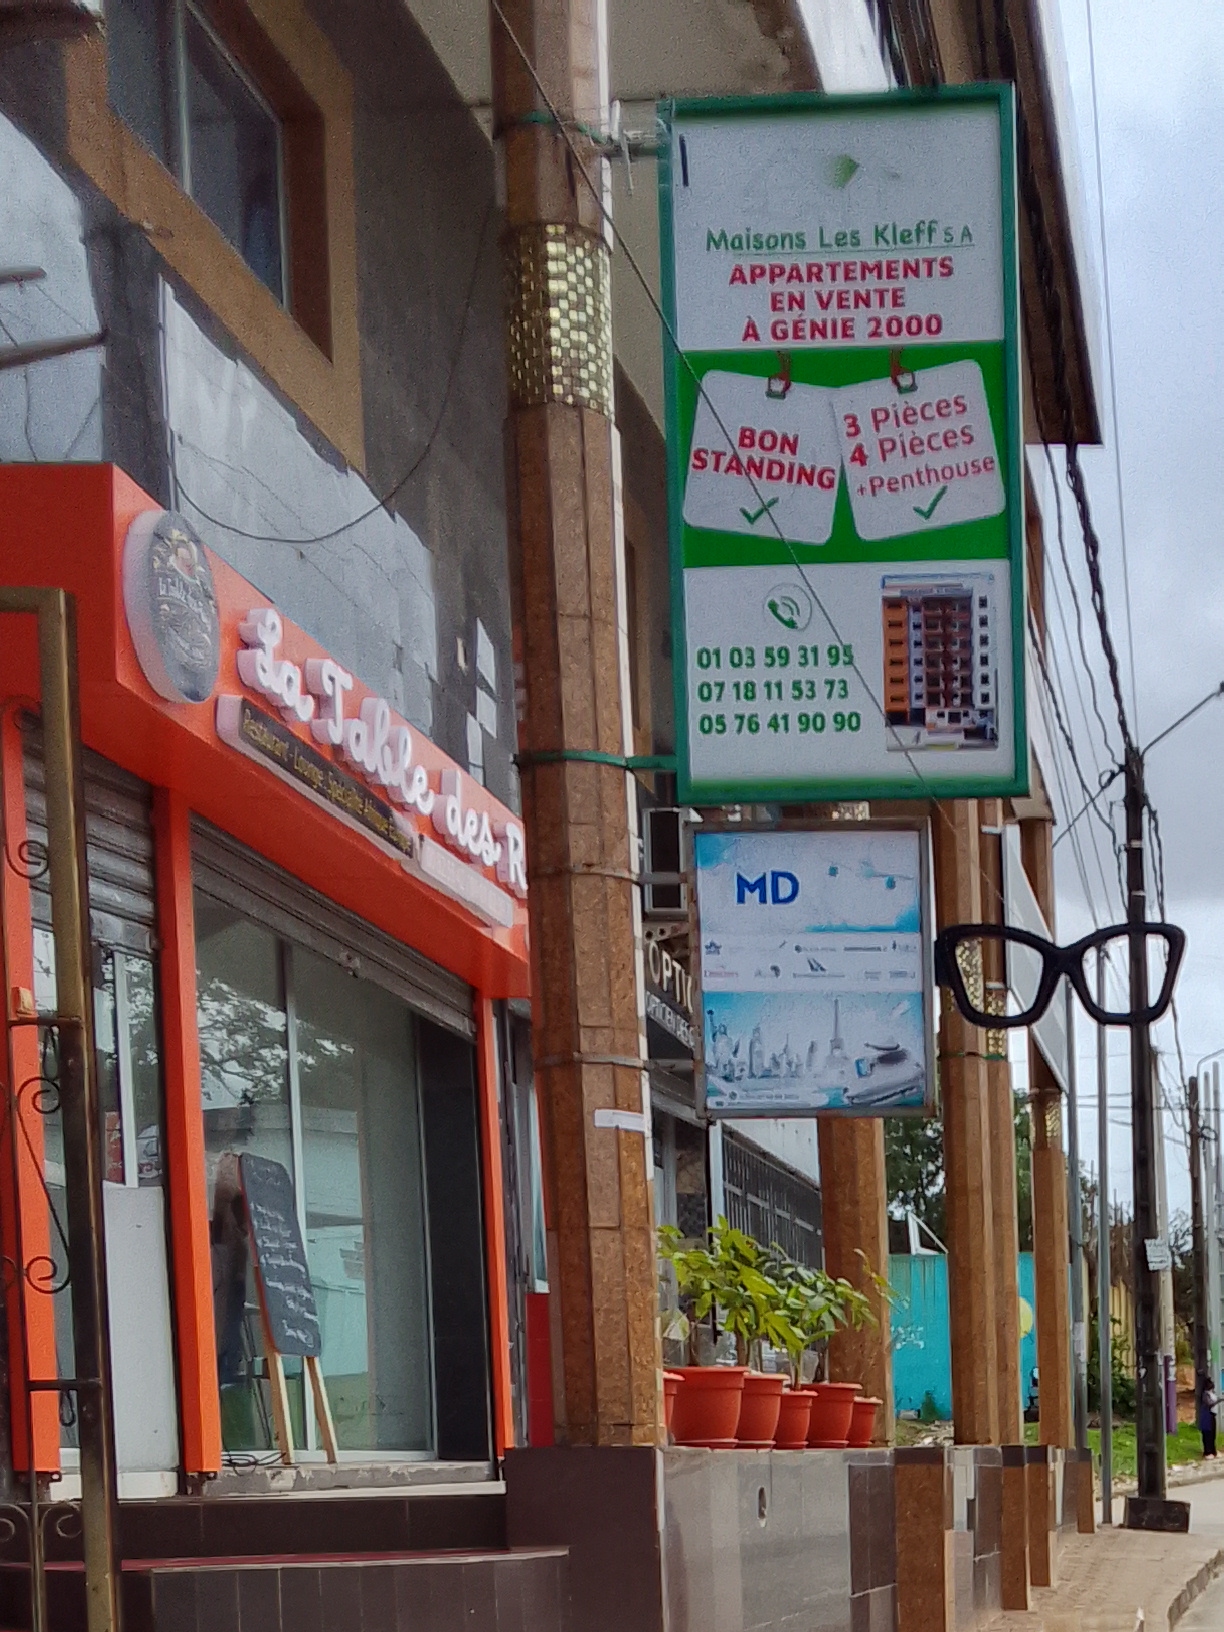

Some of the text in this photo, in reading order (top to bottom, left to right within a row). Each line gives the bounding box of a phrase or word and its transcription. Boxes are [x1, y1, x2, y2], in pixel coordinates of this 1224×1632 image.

[706, 227, 806, 251] Maisons
[819, 226, 860, 248] Les
[875, 219, 938, 247] Kleff
[729, 256, 954, 286] APPARTEMENTS
[770, 287, 906, 313] EN VENTE
[741, 312, 943, 341] À GÉNIE 2000
[843, 394, 967, 437] 3 Pièces
[738, 426, 799, 456] BON
[850, 425, 974, 467] 4 Pièces
[692, 448, 836, 490] STANDING
[697, 646, 721, 669] 01
[729, 645, 755, 668] 03
[764, 645, 790, 668] 59
[798, 644, 818, 667] 31
[698, 678, 849, 702] 07 18 11 53 73
[699, 711, 861, 735] 05 76 41 90 90
[314, 658, 435, 816] Table
[436, 768, 501, 868] des
[736, 870, 799, 905] MD
